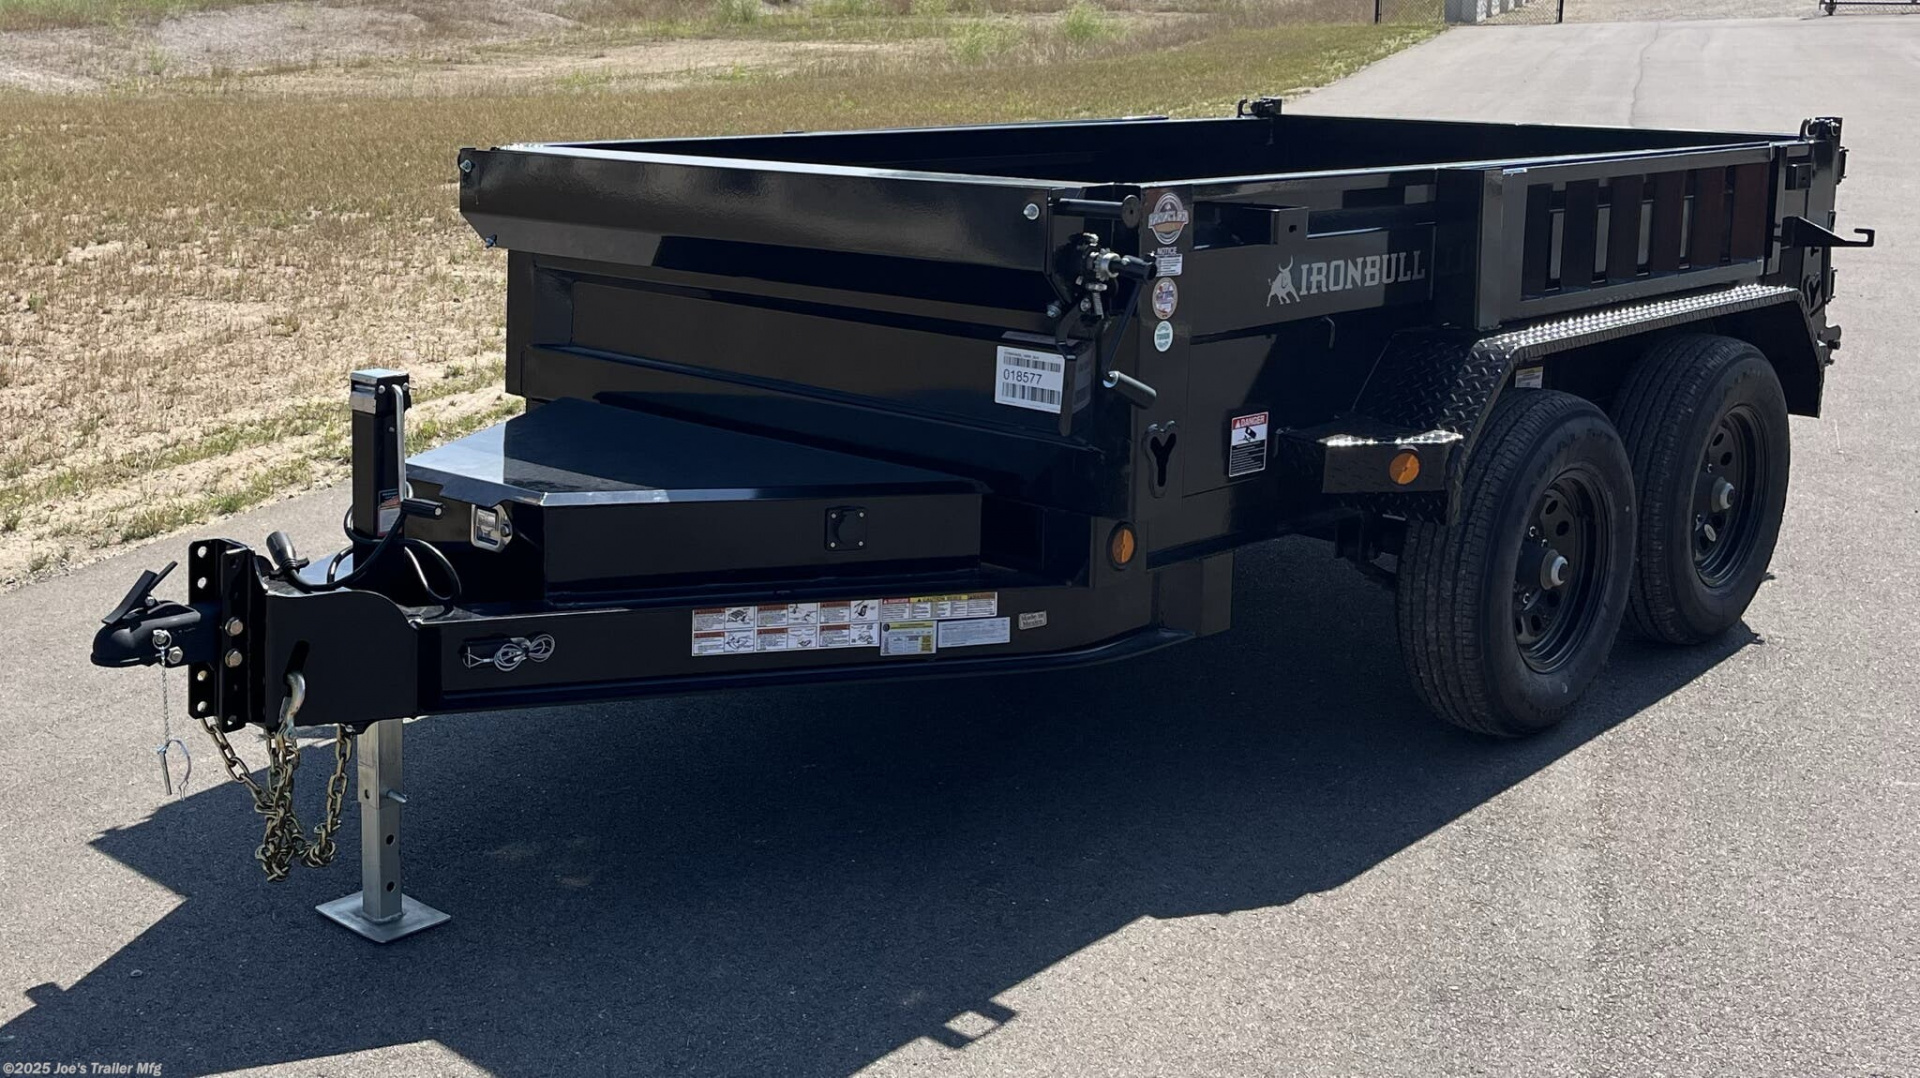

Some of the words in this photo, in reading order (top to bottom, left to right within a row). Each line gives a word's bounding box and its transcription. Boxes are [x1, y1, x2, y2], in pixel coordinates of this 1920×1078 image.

[1157, 247, 1177, 255] NOTICE
[1300, 251, 1425, 296] IRONBULL
[1003, 369, 1042, 385] 018577
